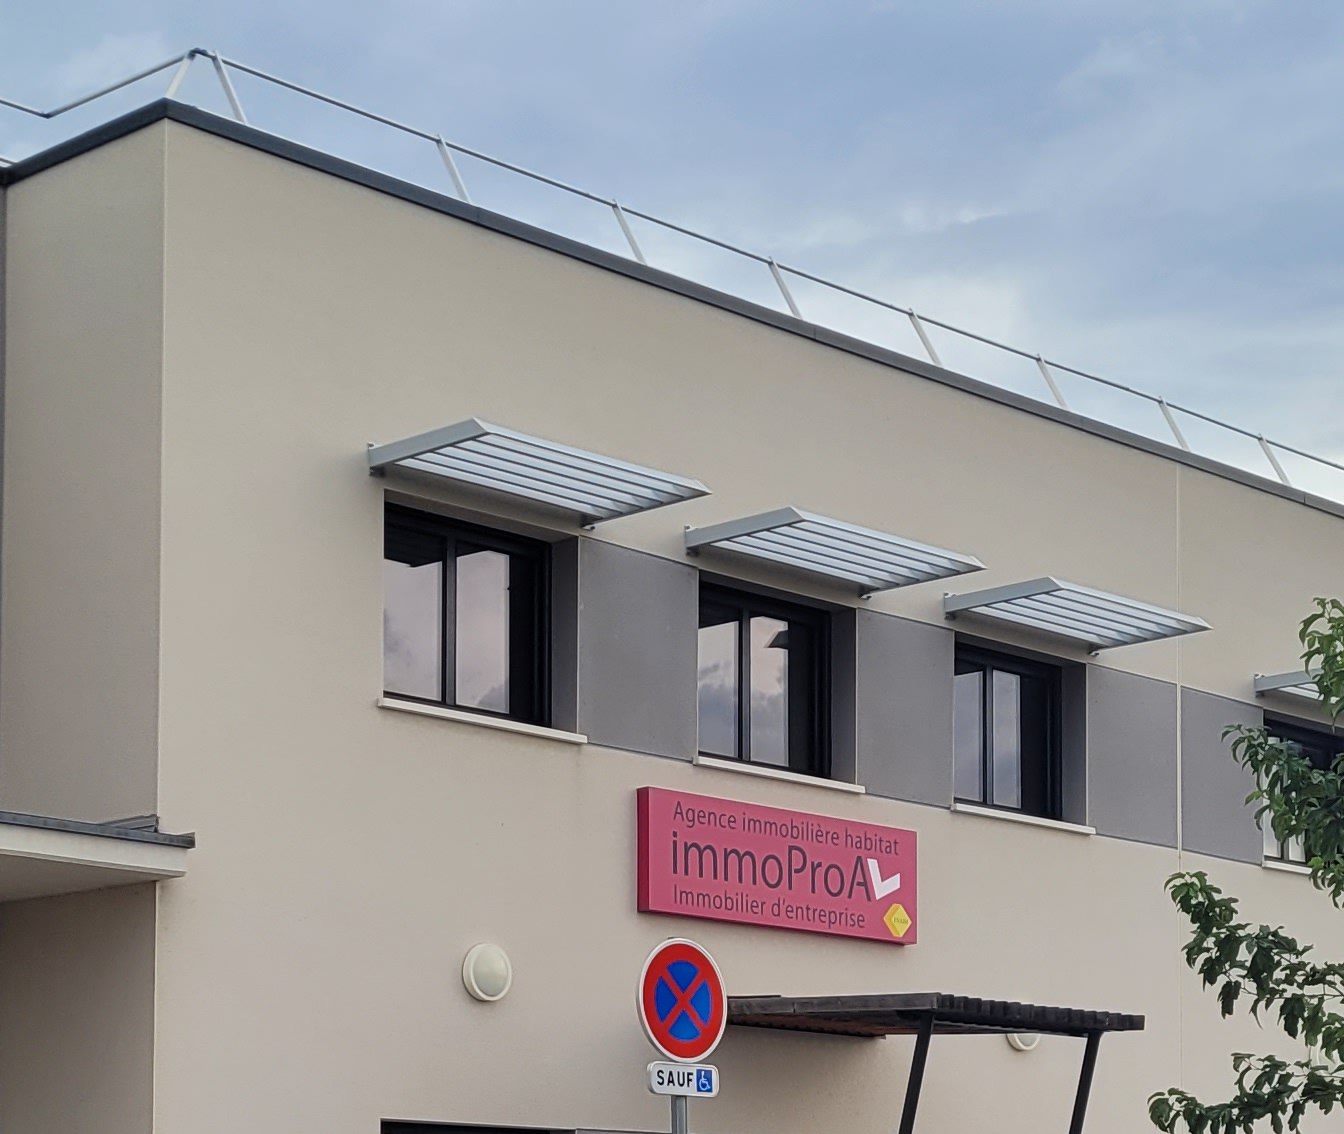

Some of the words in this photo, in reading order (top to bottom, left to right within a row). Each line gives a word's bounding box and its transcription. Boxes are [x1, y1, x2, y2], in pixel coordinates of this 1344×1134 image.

[673, 801, 737, 829] Agence
[742, 812, 840, 847] immobilière
[844, 828, 900, 856] habitat
[673, 884, 766, 915] Immobilier
[771, 897, 866, 929] d'entreprise
[656, 1069, 694, 1088] SAUF
